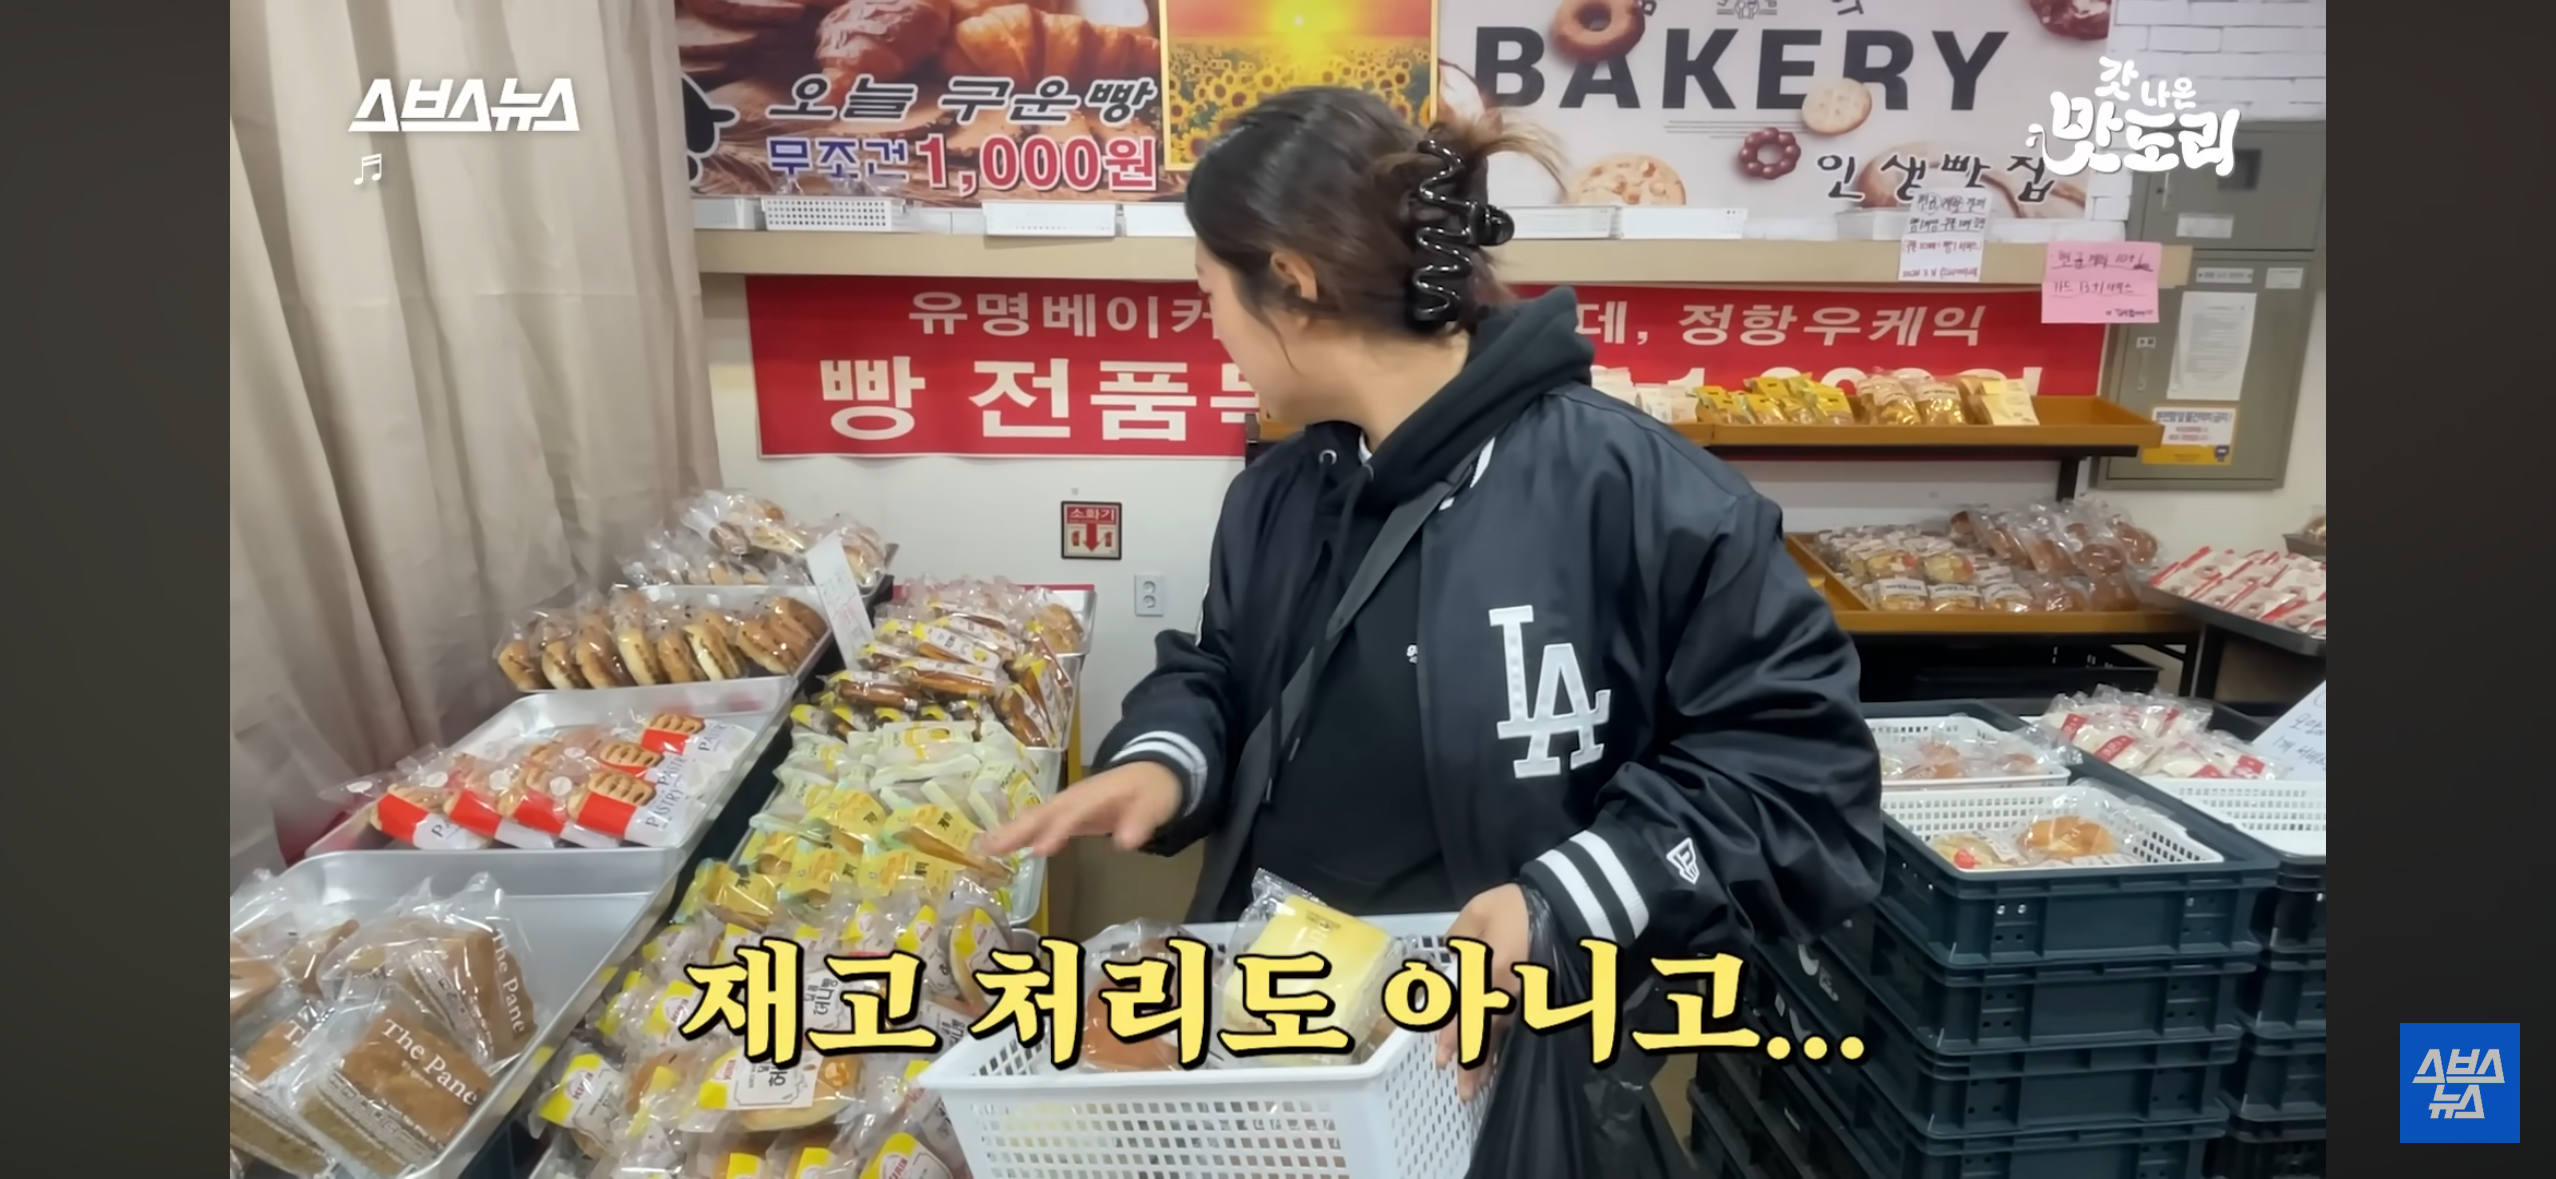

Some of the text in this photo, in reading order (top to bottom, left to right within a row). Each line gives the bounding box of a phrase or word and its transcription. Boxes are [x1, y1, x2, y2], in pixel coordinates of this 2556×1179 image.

[767, 73, 919, 122] 오늘
[1475, 26, 2009, 112] BAKERY
[767, 133, 1158, 196] 무조건 1,000원
[1678, 302, 1987, 347] 정항우케익
[819, 356, 926, 441] 빵
[1069, 507, 1116, 521] 소화기
[1488, 604, 1612, 779] LA
[502, 977, 526, 1034] Pane
[381, 1018, 426, 1061] The
[423, 1054, 478, 1106] Pane
